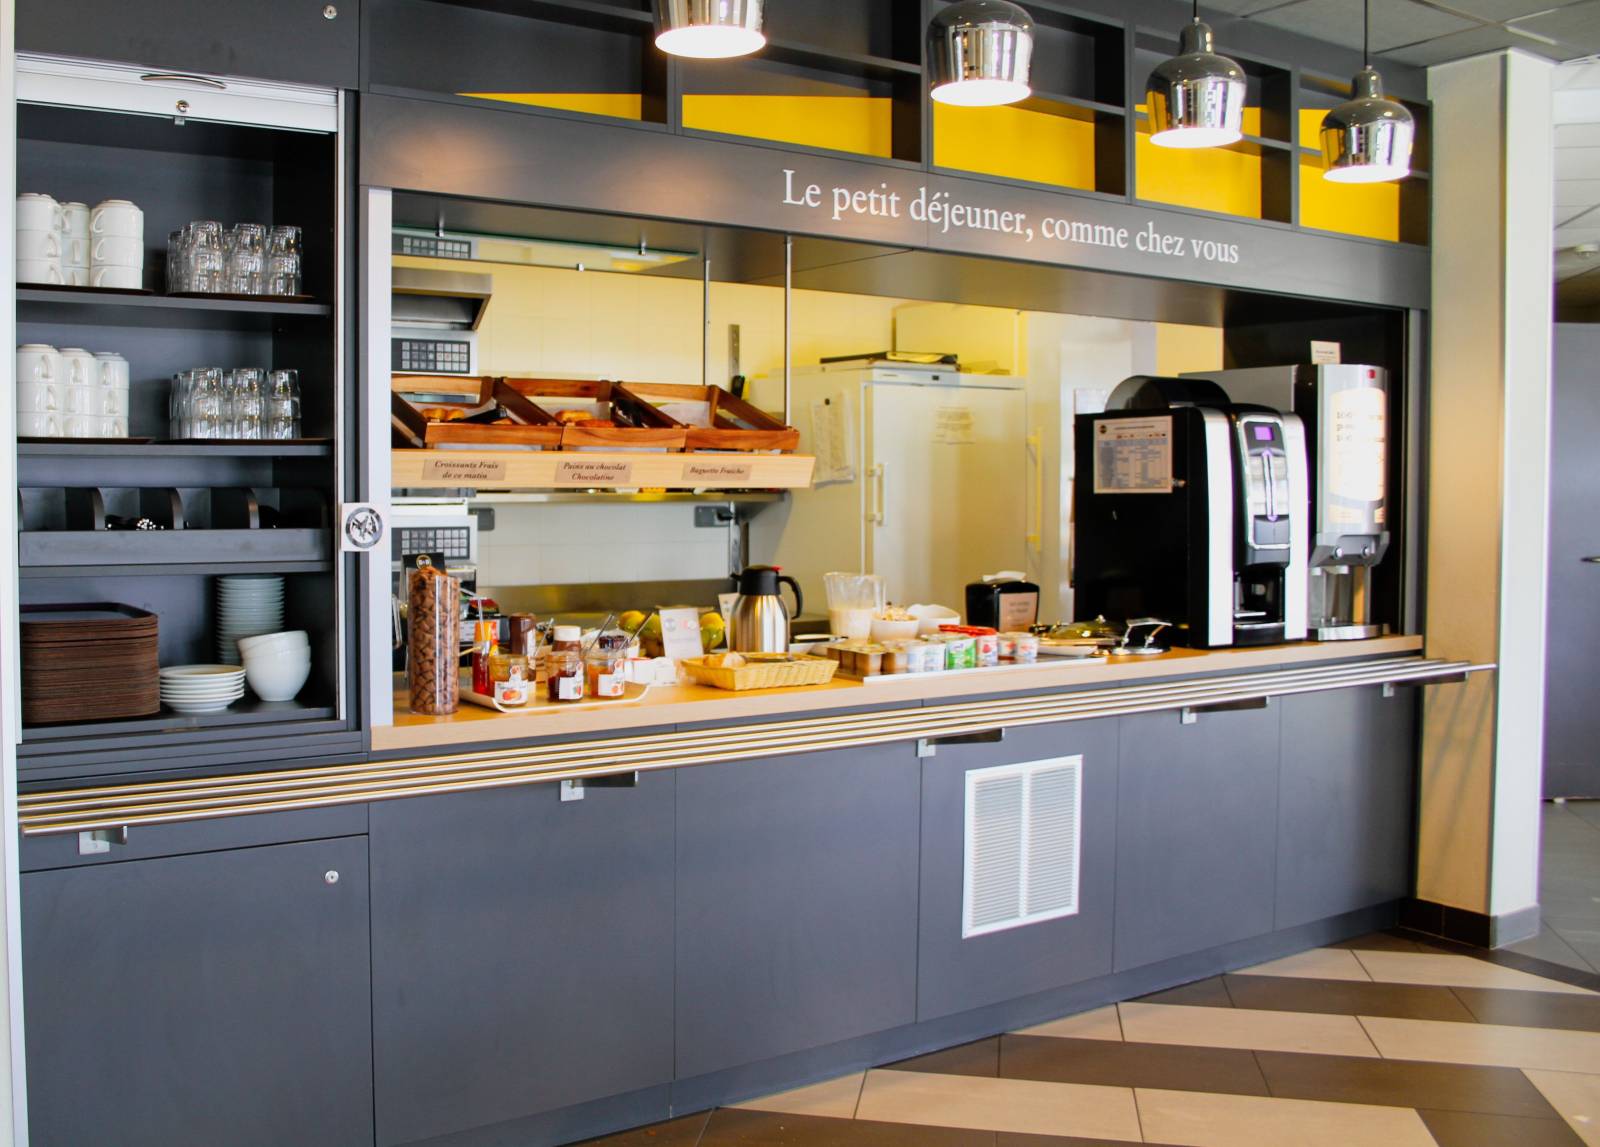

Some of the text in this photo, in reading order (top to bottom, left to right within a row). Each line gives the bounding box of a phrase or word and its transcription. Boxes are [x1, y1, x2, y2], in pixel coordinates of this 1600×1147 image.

[782, 169, 1239, 264] Le petit déjeuner, comme chez vous
[434, 460, 499, 469] Croissants Frais
[596, 463, 626, 471] chocolat
[571, 472, 615, 481] Chocolatine
